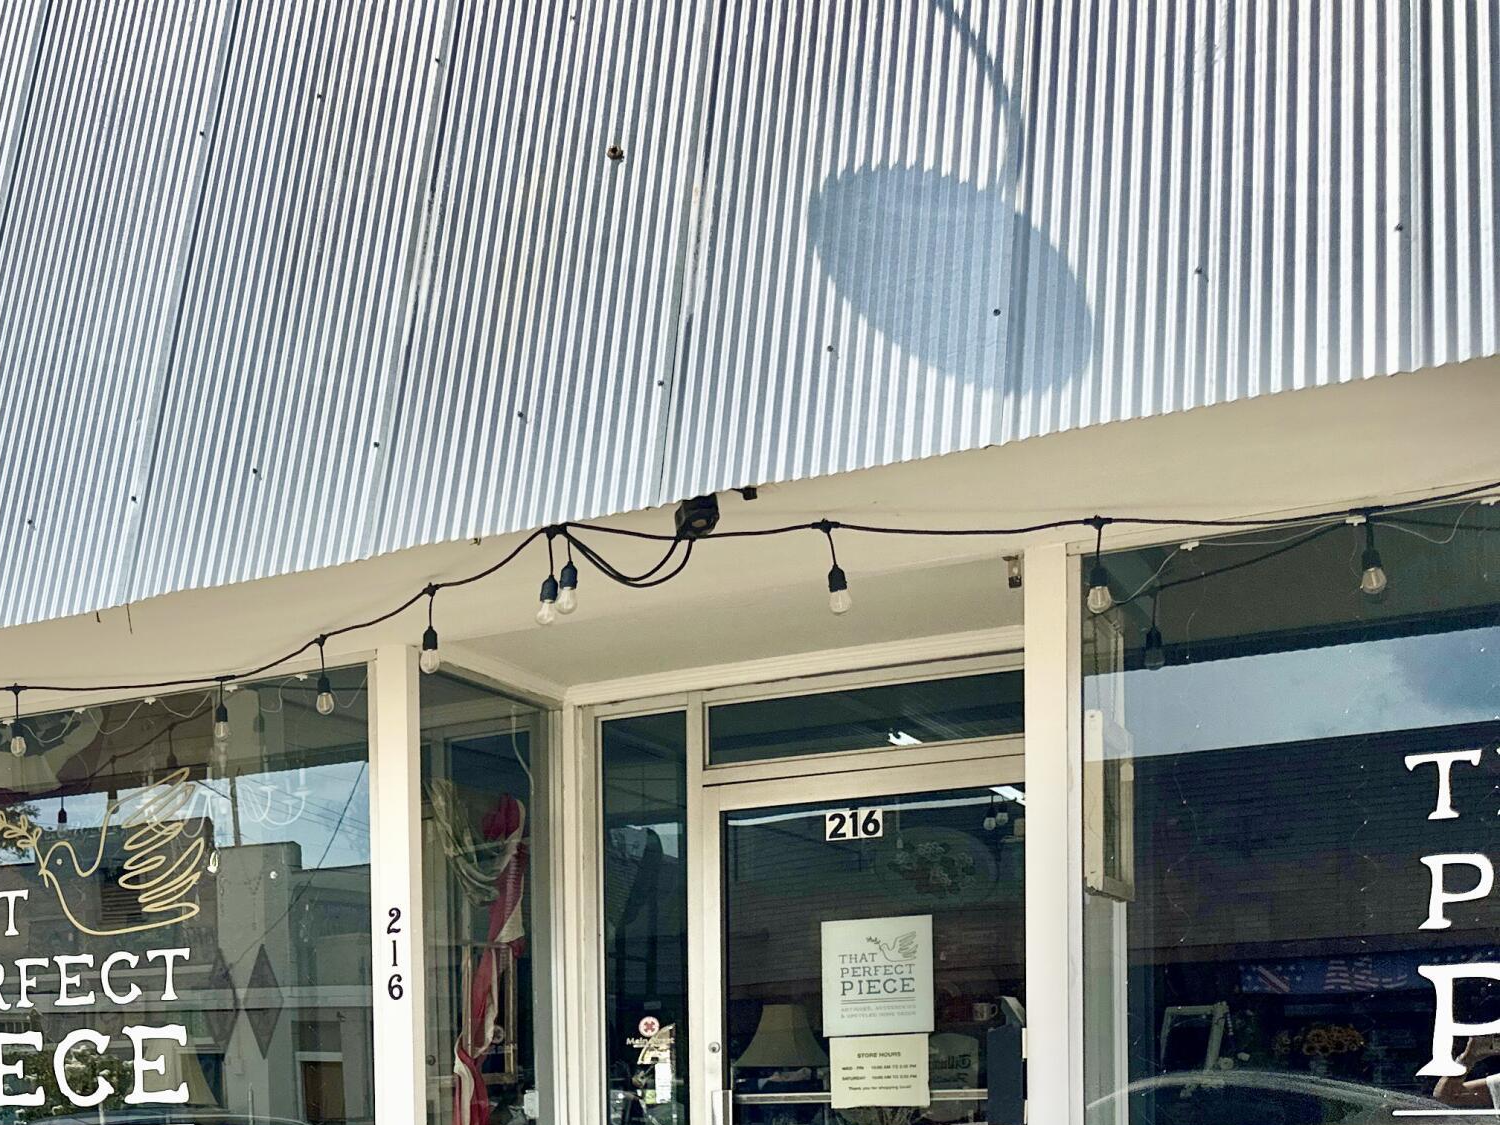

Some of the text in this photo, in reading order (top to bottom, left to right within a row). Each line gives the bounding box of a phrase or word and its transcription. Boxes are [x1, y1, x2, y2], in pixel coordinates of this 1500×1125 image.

[1404, 748, 1500, 820] T
[828, 809, 881, 839] 216
[838, 952, 877, 964] THAT
[840, 964, 916, 978] PERFECT
[840, 977, 915, 996] PIECE
